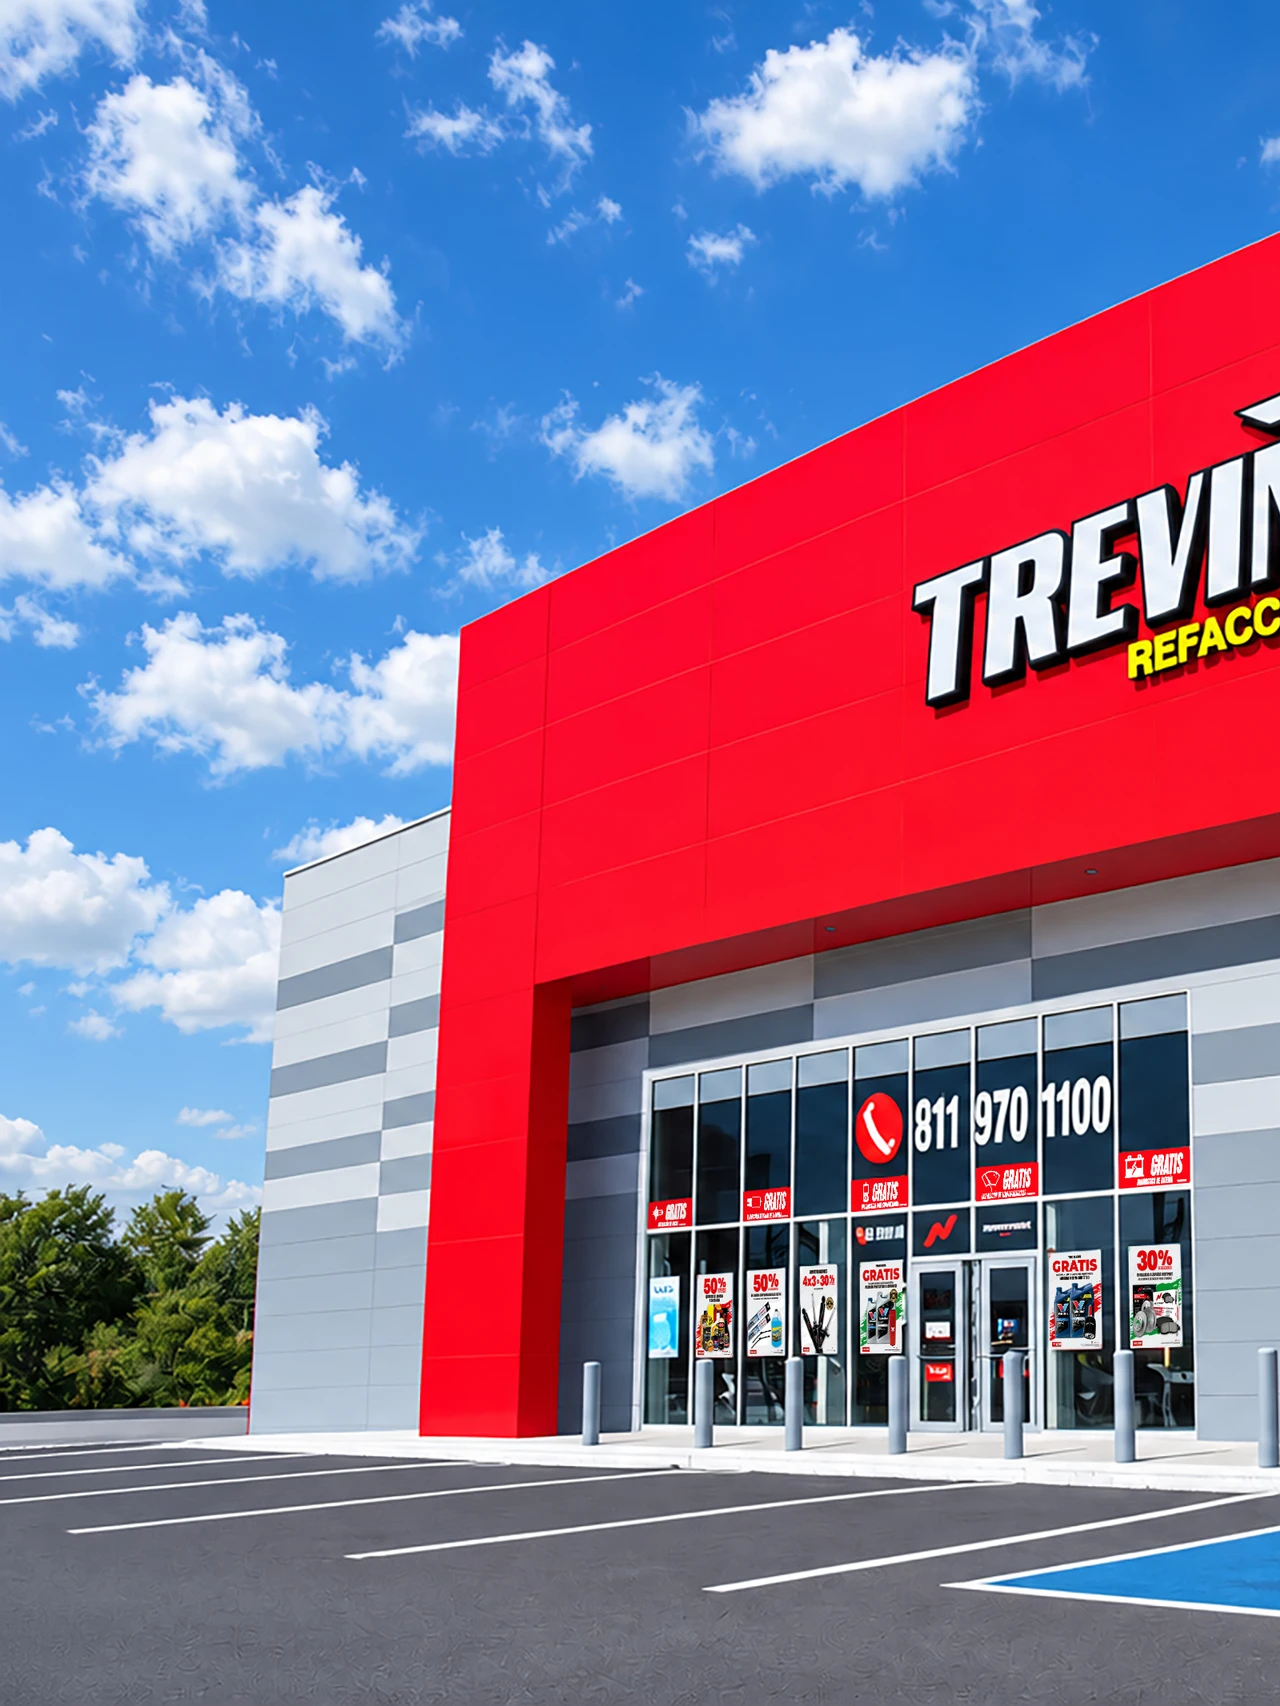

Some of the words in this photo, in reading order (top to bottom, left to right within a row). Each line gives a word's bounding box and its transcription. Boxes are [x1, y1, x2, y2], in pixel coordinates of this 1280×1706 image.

[914, 1094, 959, 1152] 811
[974, 1085, 1029, 1146] 970
[1041, 1075, 1112, 1138] 1100
[1150, 1151, 1184, 1176] GRATIS
[1002, 1167, 1032, 1190] GRATIS
[763, 1191, 788, 1211] GRATIS
[871, 1181, 899, 1202] GRATIS
[1052, 1258, 1098, 1273] GRATIS
[1136, 1249, 1173, 1271] 30%
[753, 1273, 779, 1292] 50%
[802, 1275, 817, 1287] 4x3
[862, 1267, 900, 1282] GRATIS
[703, 1277, 727, 1295] 50%
